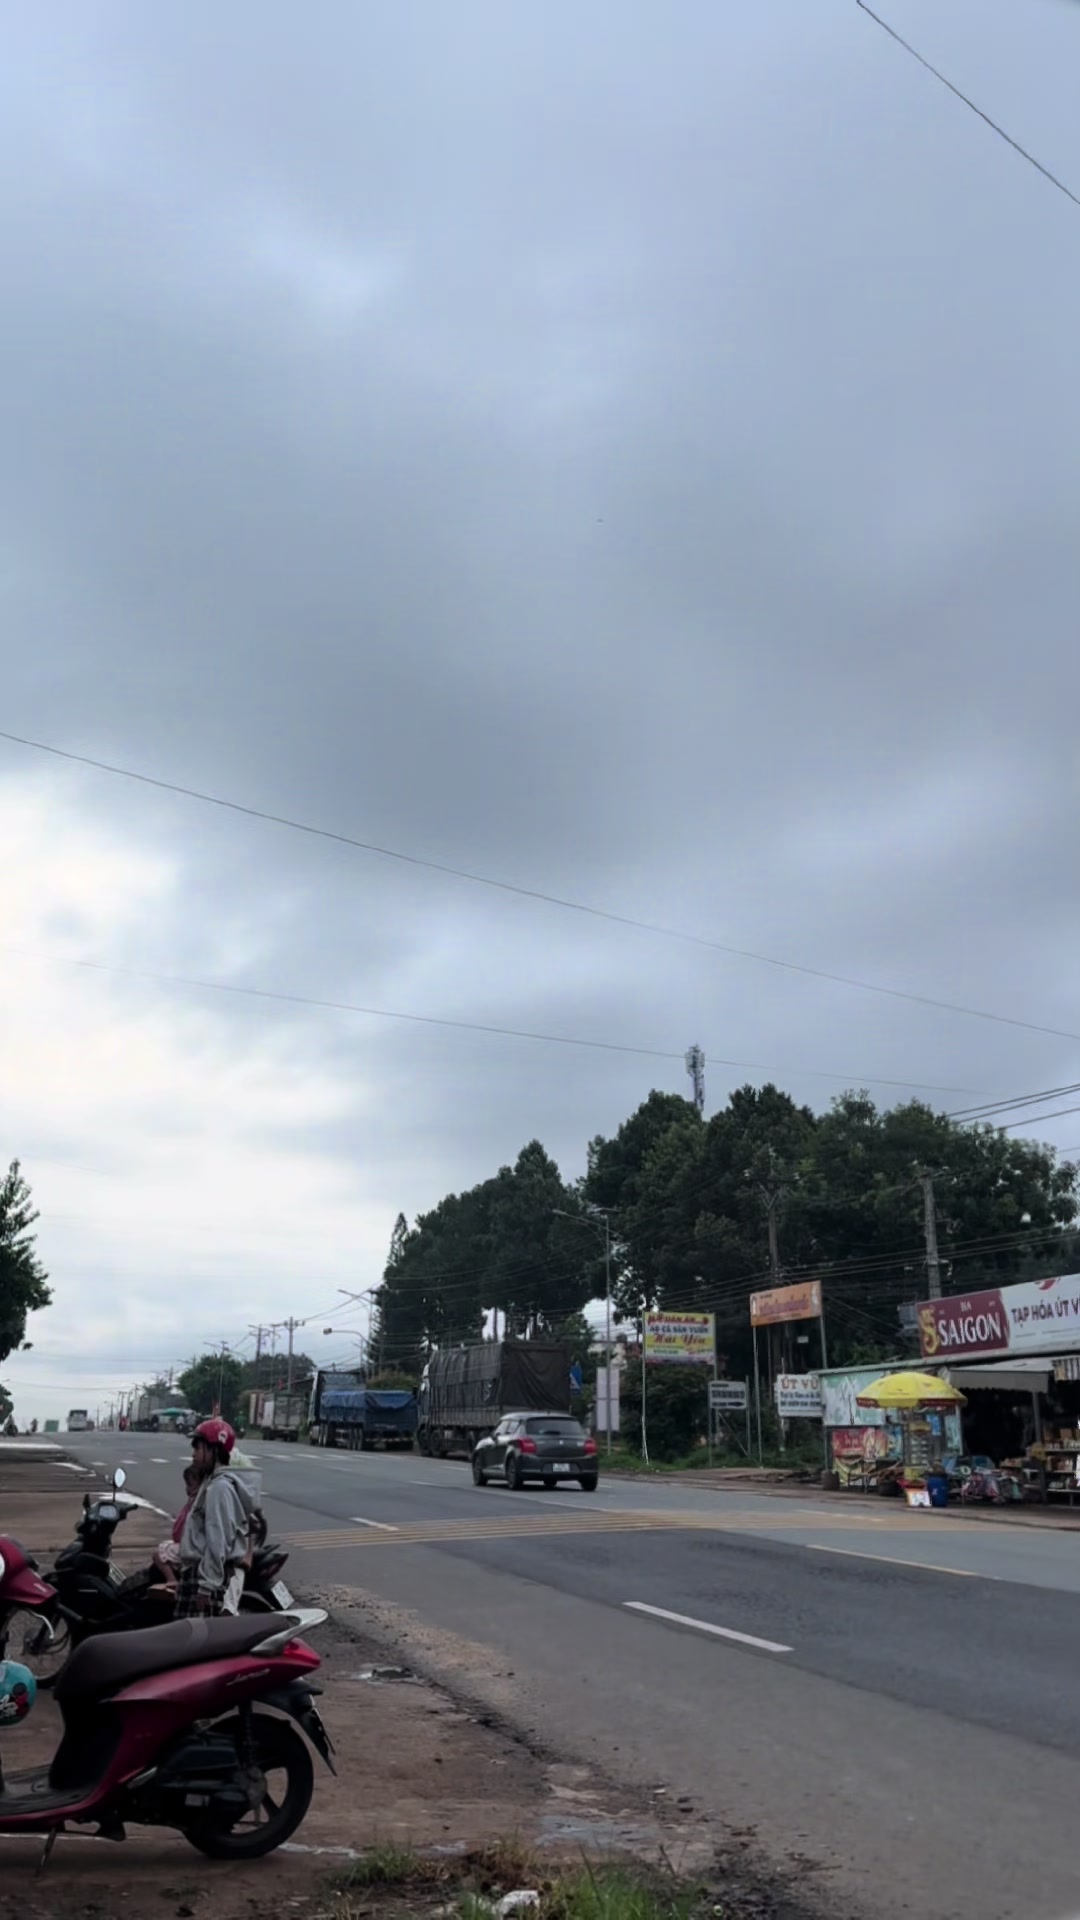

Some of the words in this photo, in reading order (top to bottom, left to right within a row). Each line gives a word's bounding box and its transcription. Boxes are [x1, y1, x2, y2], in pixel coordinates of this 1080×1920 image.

[938, 1311, 1002, 1346] SAIGON
[1011, 1306, 1030, 1328] TẠP
[1031, 1299, 1054, 1321] HÓA
[1055, 1296, 1069, 1317] ÚT
